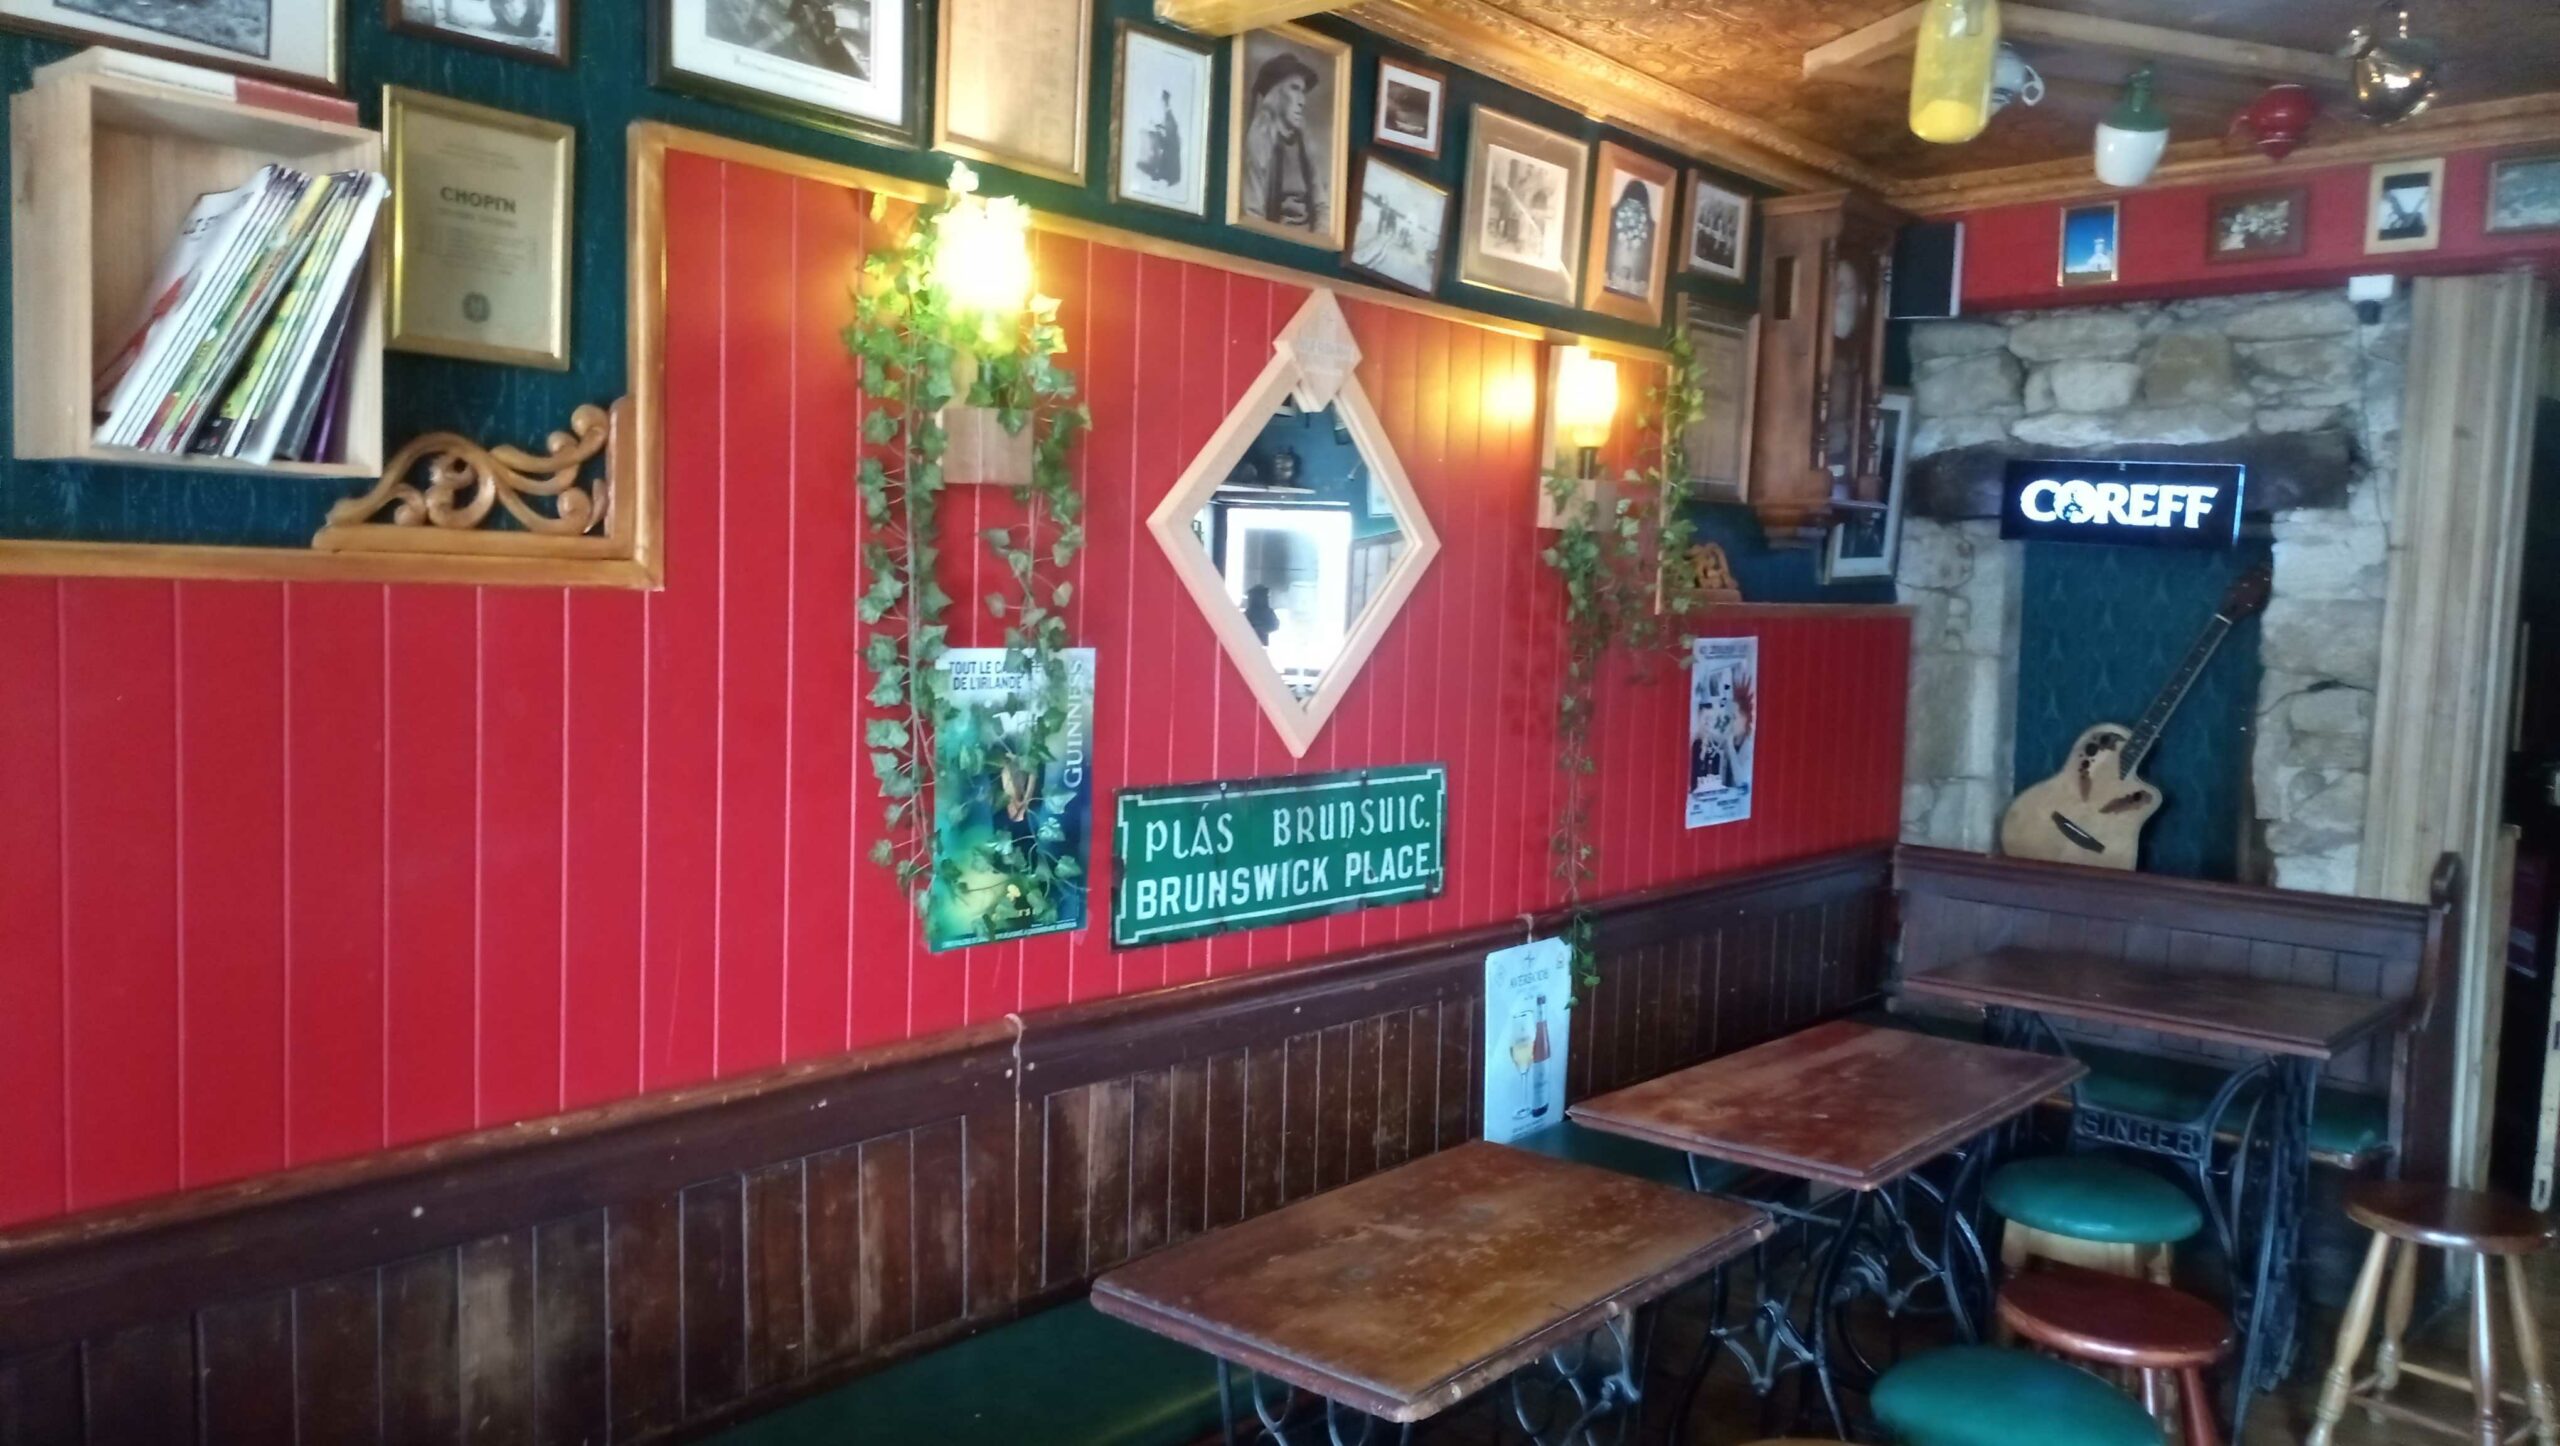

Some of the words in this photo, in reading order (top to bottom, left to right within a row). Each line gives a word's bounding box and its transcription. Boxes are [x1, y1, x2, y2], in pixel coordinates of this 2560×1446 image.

[439, 186, 516, 213] CHOPIN
[2020, 479, 2219, 528] COREFF
[950, 661, 977, 675] TOUT
[980, 661, 991, 674] LE
[953, 677, 967, 690] DE
[970, 675, 1022, 690] L'IRLANDE
[1063, 660, 1083, 788] GUINNESS
[1136, 855, 1329, 920] BRUNSWICK
[2082, 1111, 2198, 1157] SINGER
